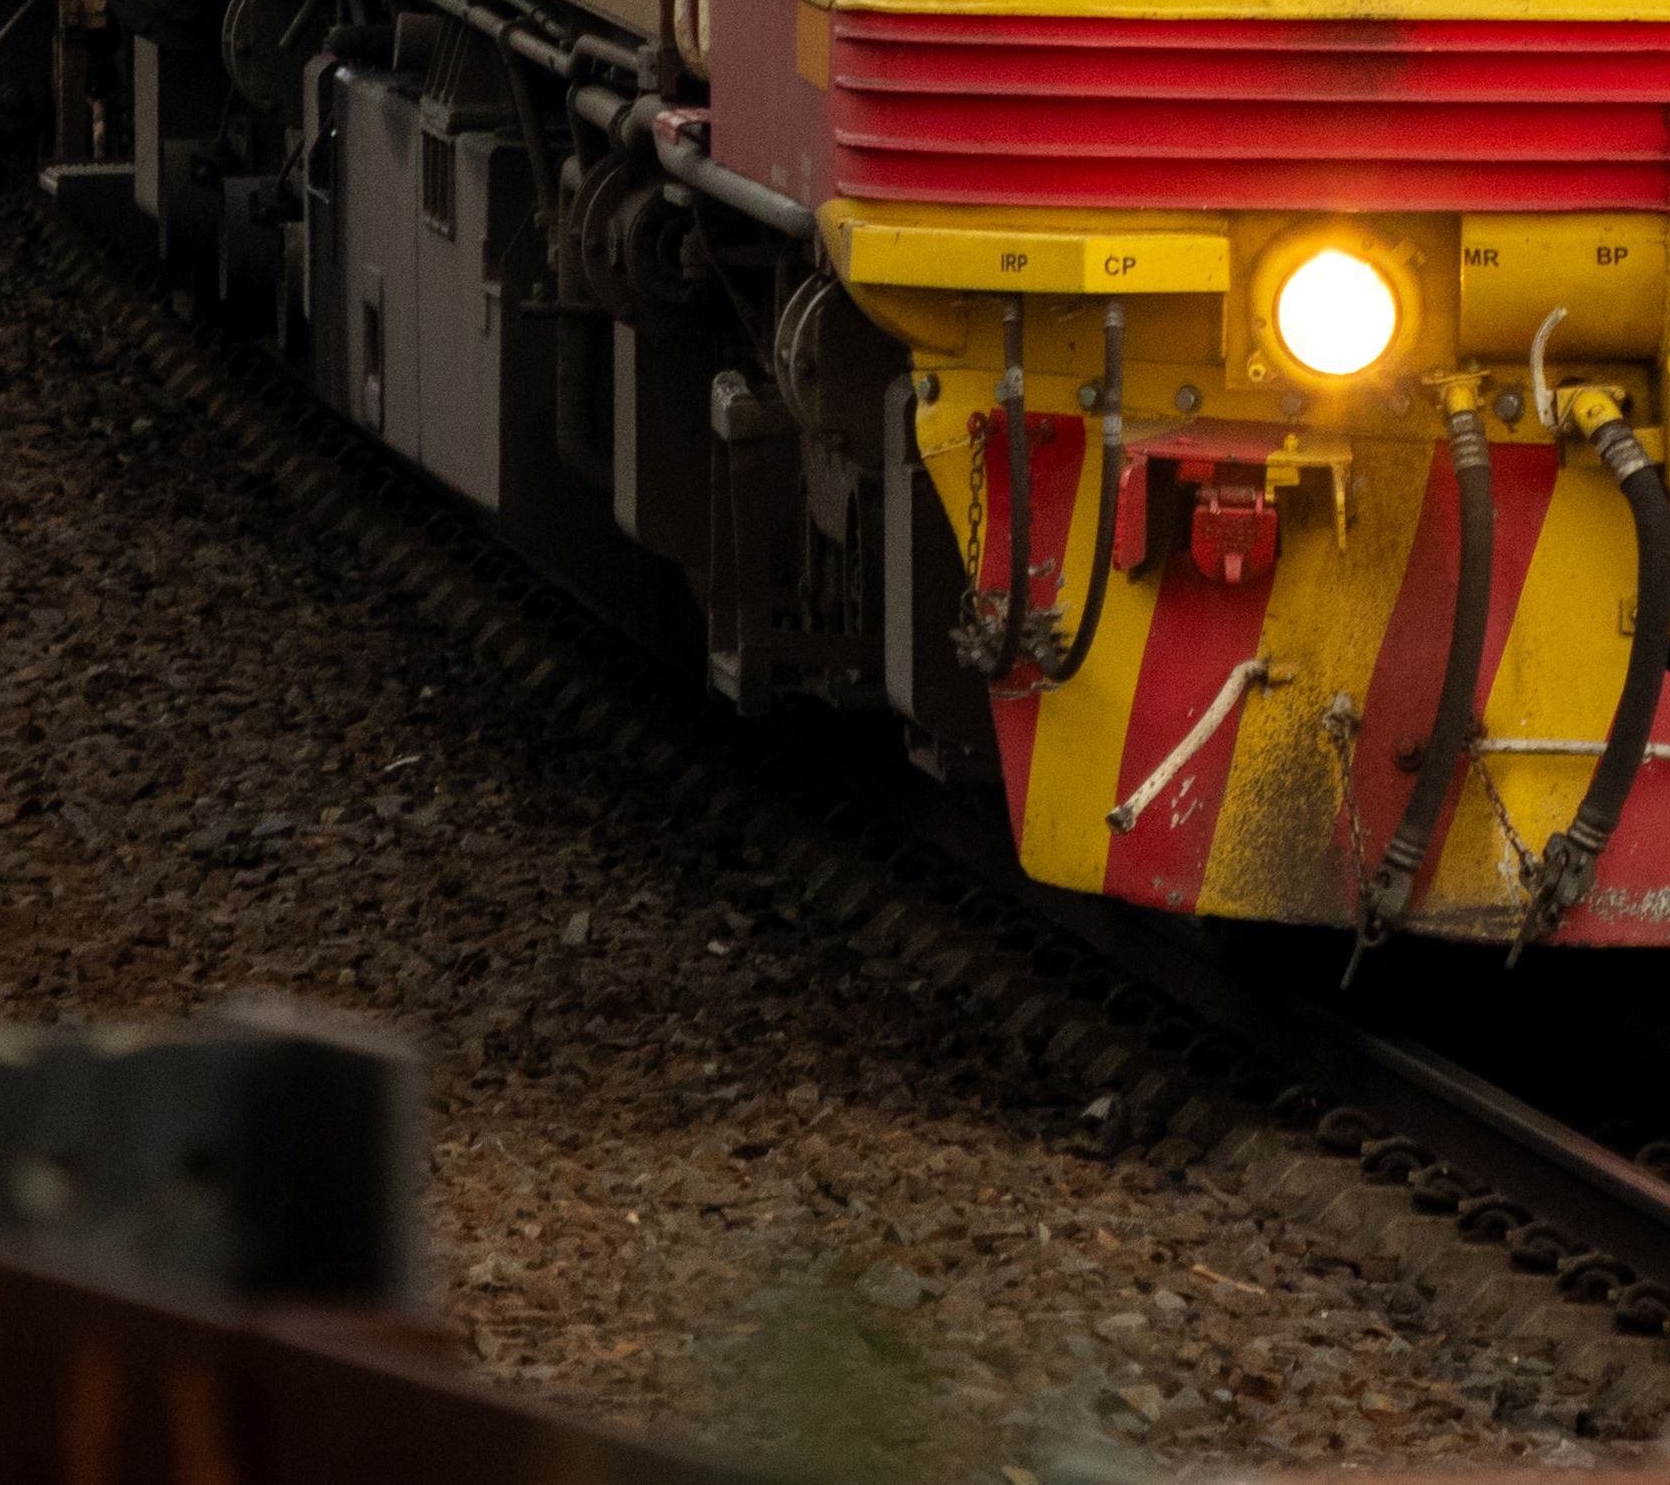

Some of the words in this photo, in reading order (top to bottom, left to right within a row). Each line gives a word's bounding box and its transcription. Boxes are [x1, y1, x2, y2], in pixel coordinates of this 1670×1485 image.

[999, 252, 1029, 274] IRP
[1103, 255, 1137, 277] CP
[1463, 247, 1500, 268] MR
[1596, 245, 1629, 266] BP
